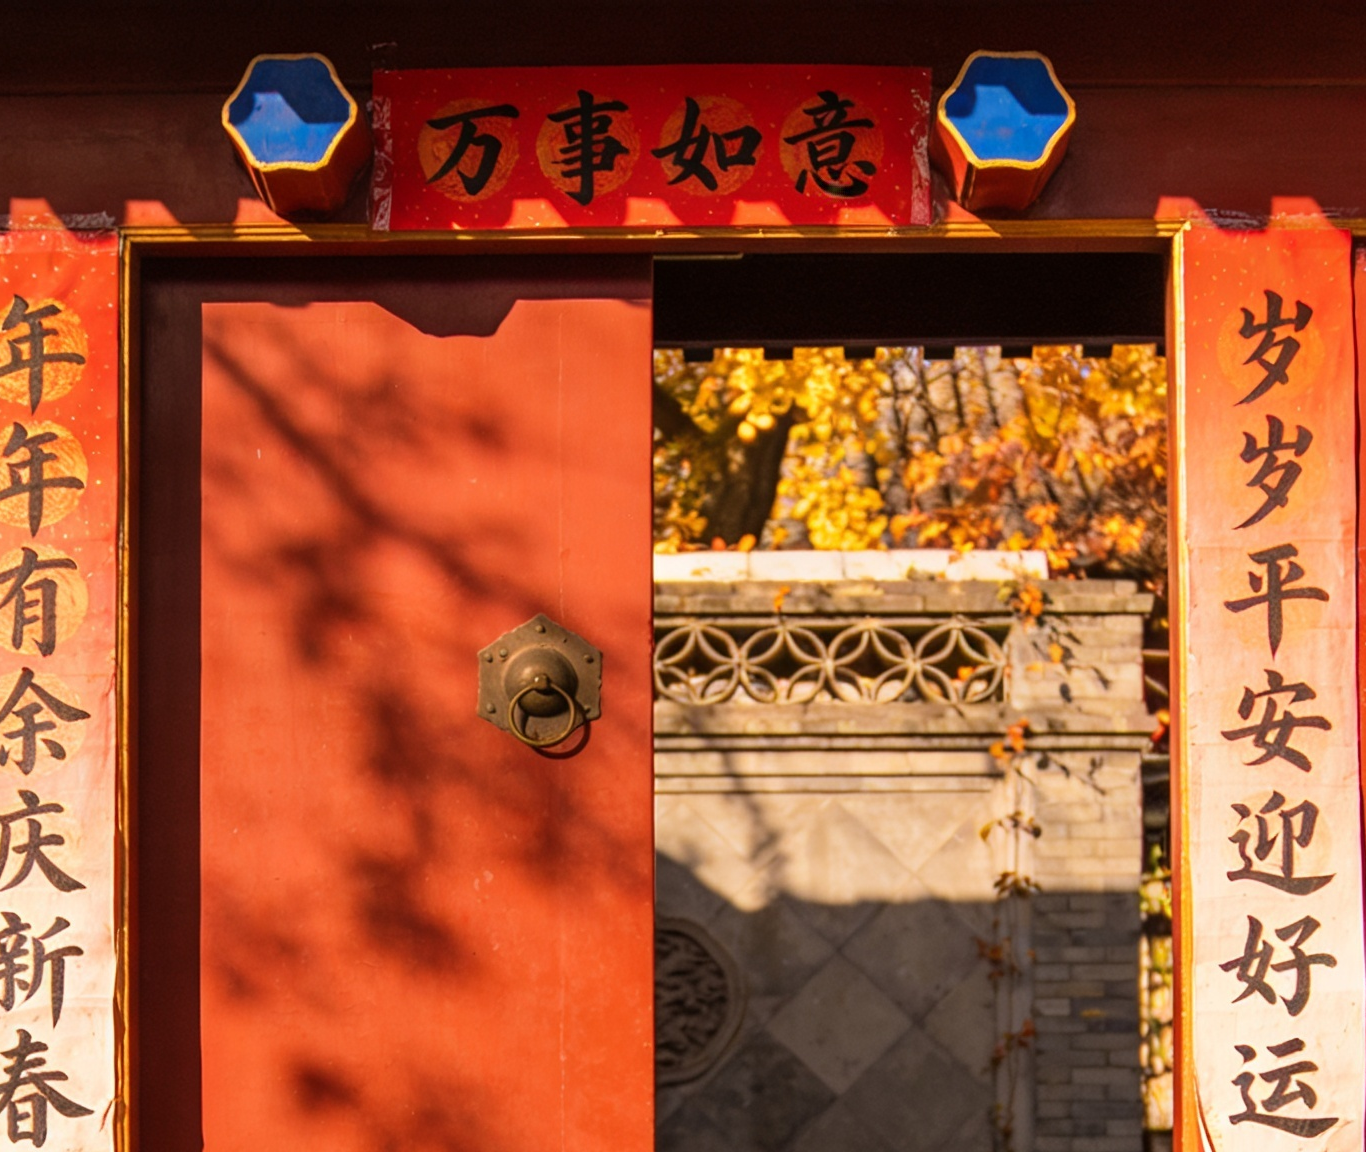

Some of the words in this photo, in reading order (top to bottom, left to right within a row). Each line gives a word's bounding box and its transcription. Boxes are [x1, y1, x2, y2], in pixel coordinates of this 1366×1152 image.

[425, 89, 877, 206] 万事如意
[1219, 289, 1339, 1140] 岁岁平安迎好运
